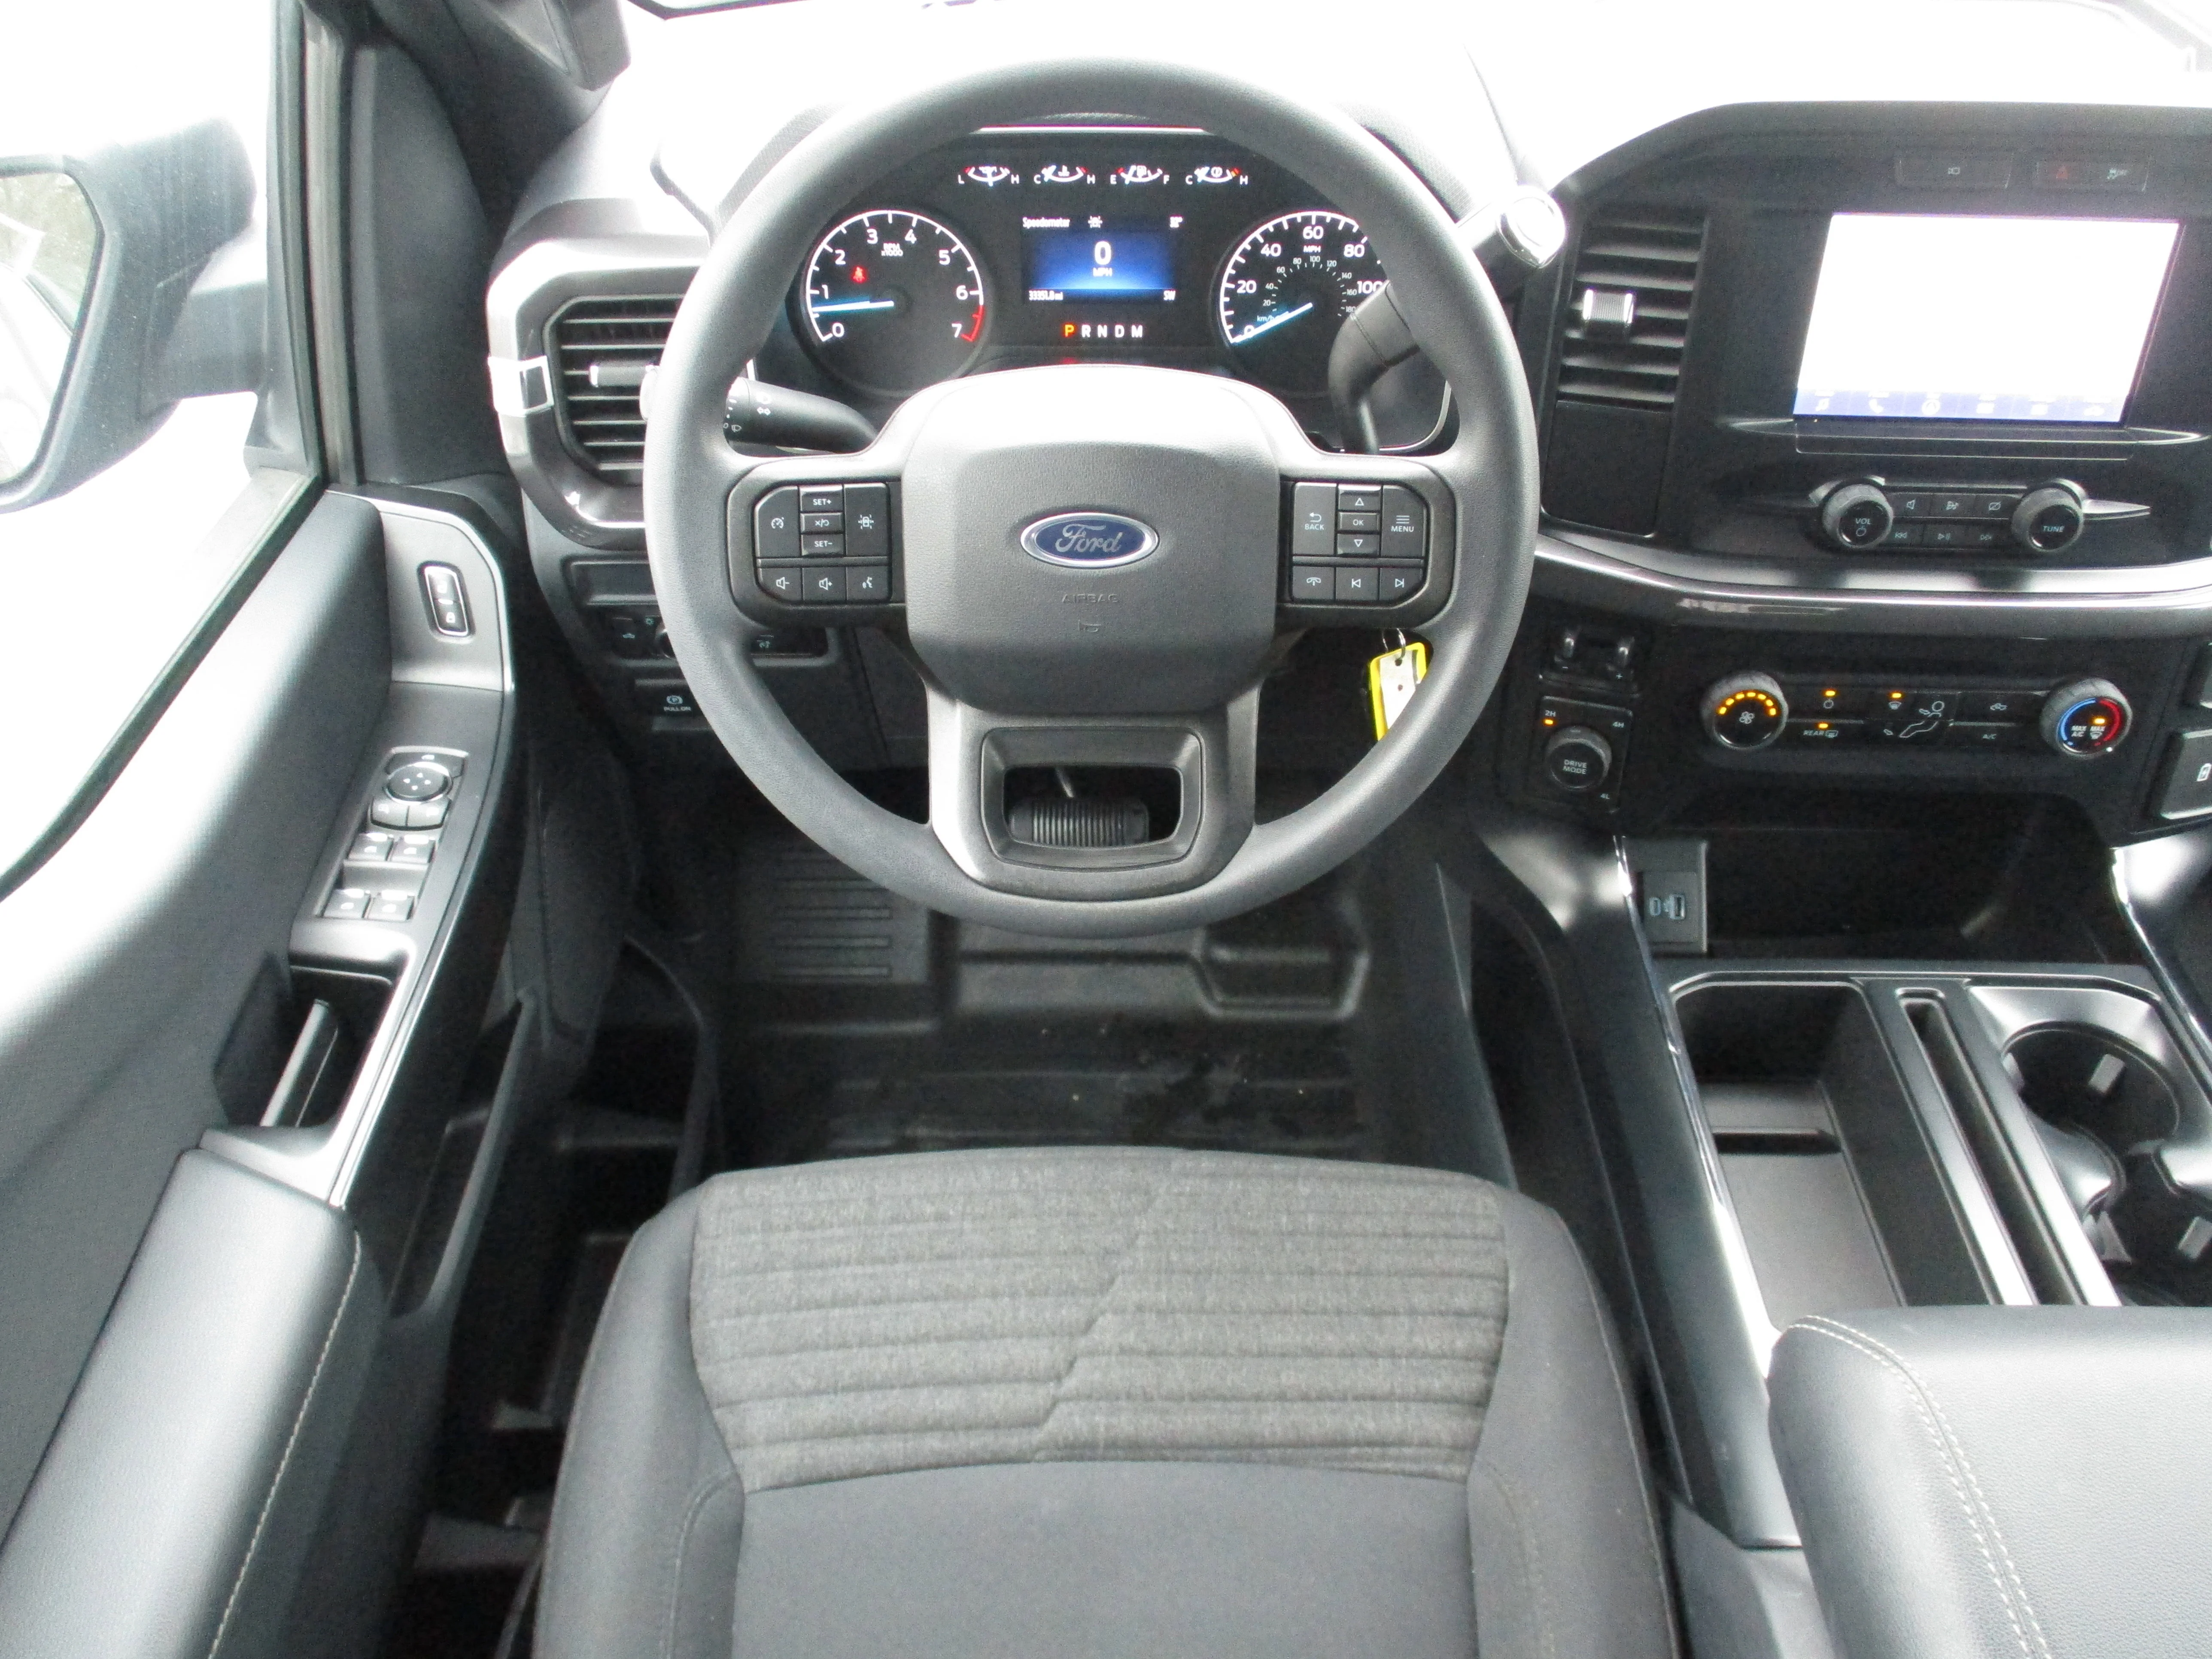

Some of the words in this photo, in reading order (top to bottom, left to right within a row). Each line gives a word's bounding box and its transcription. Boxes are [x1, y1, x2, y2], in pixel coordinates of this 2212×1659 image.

[957, 174, 965, 184] L
[1011, 174, 1020, 184] H
[1033, 174, 1041, 184] C
[1087, 174, 1096, 184] H
[1110, 174, 1117, 185] E
[1163, 175, 1170, 185] F
[1185, 175, 1193, 185] C
[1240, 175, 1249, 185] H
[1022, 217, 1070, 229] Speedometer
[866, 228, 878, 244] 3
[904, 229, 917, 244] 4
[1302, 226, 1324, 240] 60
[1095, 241, 1111, 265] 0
[1260, 243, 1282, 257] 40
[1343, 244, 1365, 258] 80
[835, 249, 846, 265] 2
[939, 249, 951, 266] 5
[1093, 267, 1112, 276] MPH
[821, 284, 829, 299] 1
[956, 285, 969, 301] 6
[1237, 280, 1257, 294] 20
[1164, 290, 1176, 301] SW
[832, 322, 845, 338] 0
[951, 323, 962, 339] 7
[1065, 324, 1074, 336] P
[1081, 324, 1091, 338] R
[1097, 324, 1108, 338] N
[1114, 325, 1125, 338] D
[1131, 325, 1143, 338] M
[1391, 525, 1414, 533] MENU
[1055, 523, 1122, 553] Ford
[1062, 593, 1120, 603] AIRBAG
[1562, 765, 1587, 775] MODE
[1564, 759, 1587, 769] DRIVE
